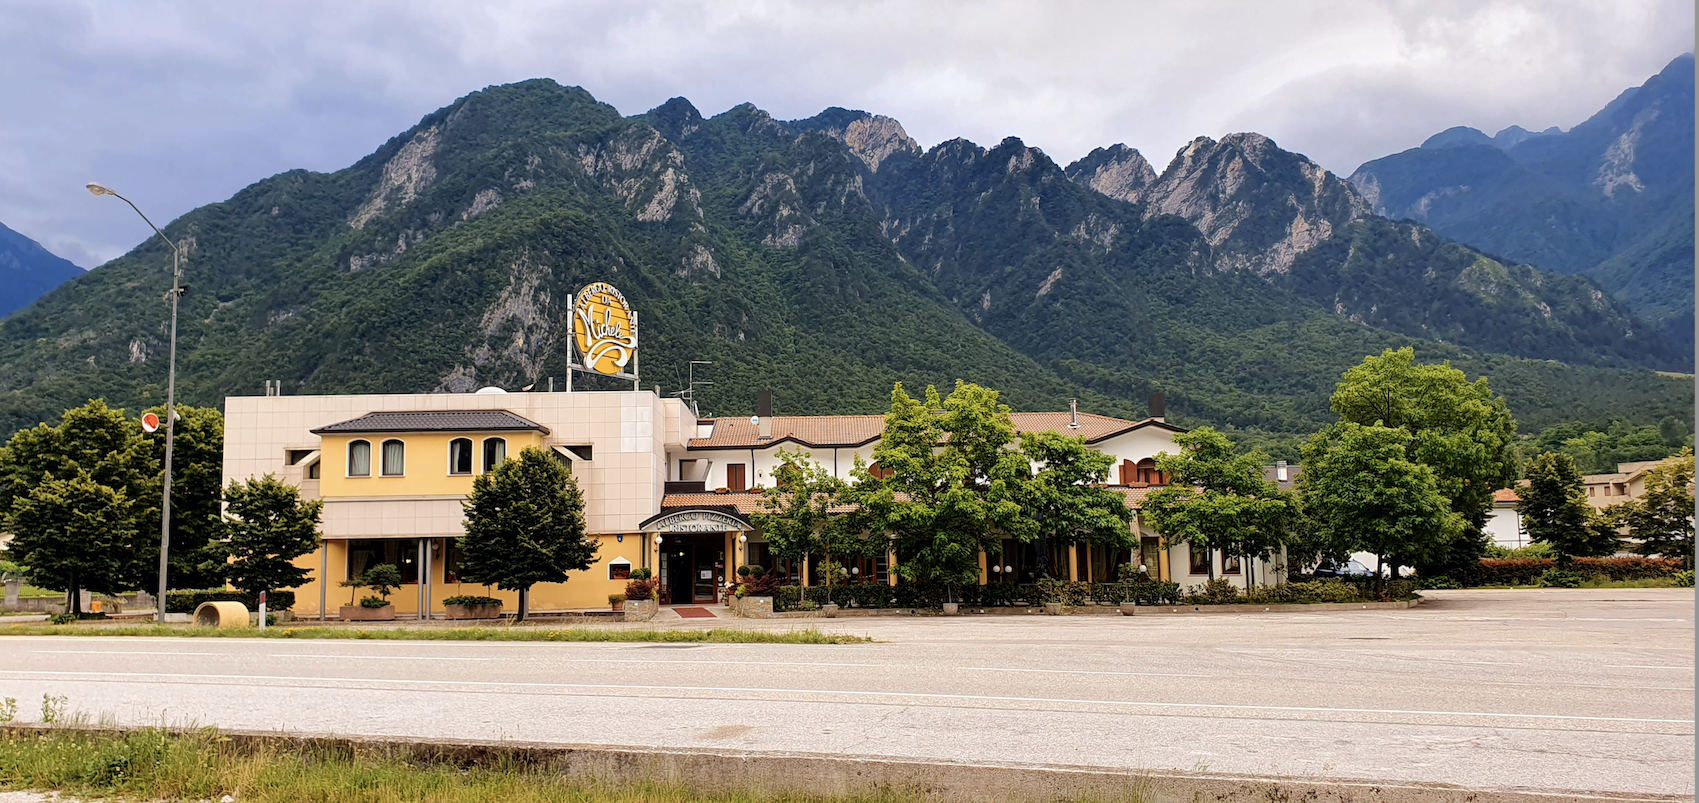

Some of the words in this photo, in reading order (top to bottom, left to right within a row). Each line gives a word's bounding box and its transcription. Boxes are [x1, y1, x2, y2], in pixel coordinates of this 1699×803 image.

[579, 284, 605, 310] ALBERGO
[576, 304, 636, 348] Michele
[659, 513, 698, 528] ALBERGO
[703, 512, 741, 529] PIZZERIA
[670, 524, 727, 532] RISTORANTE
